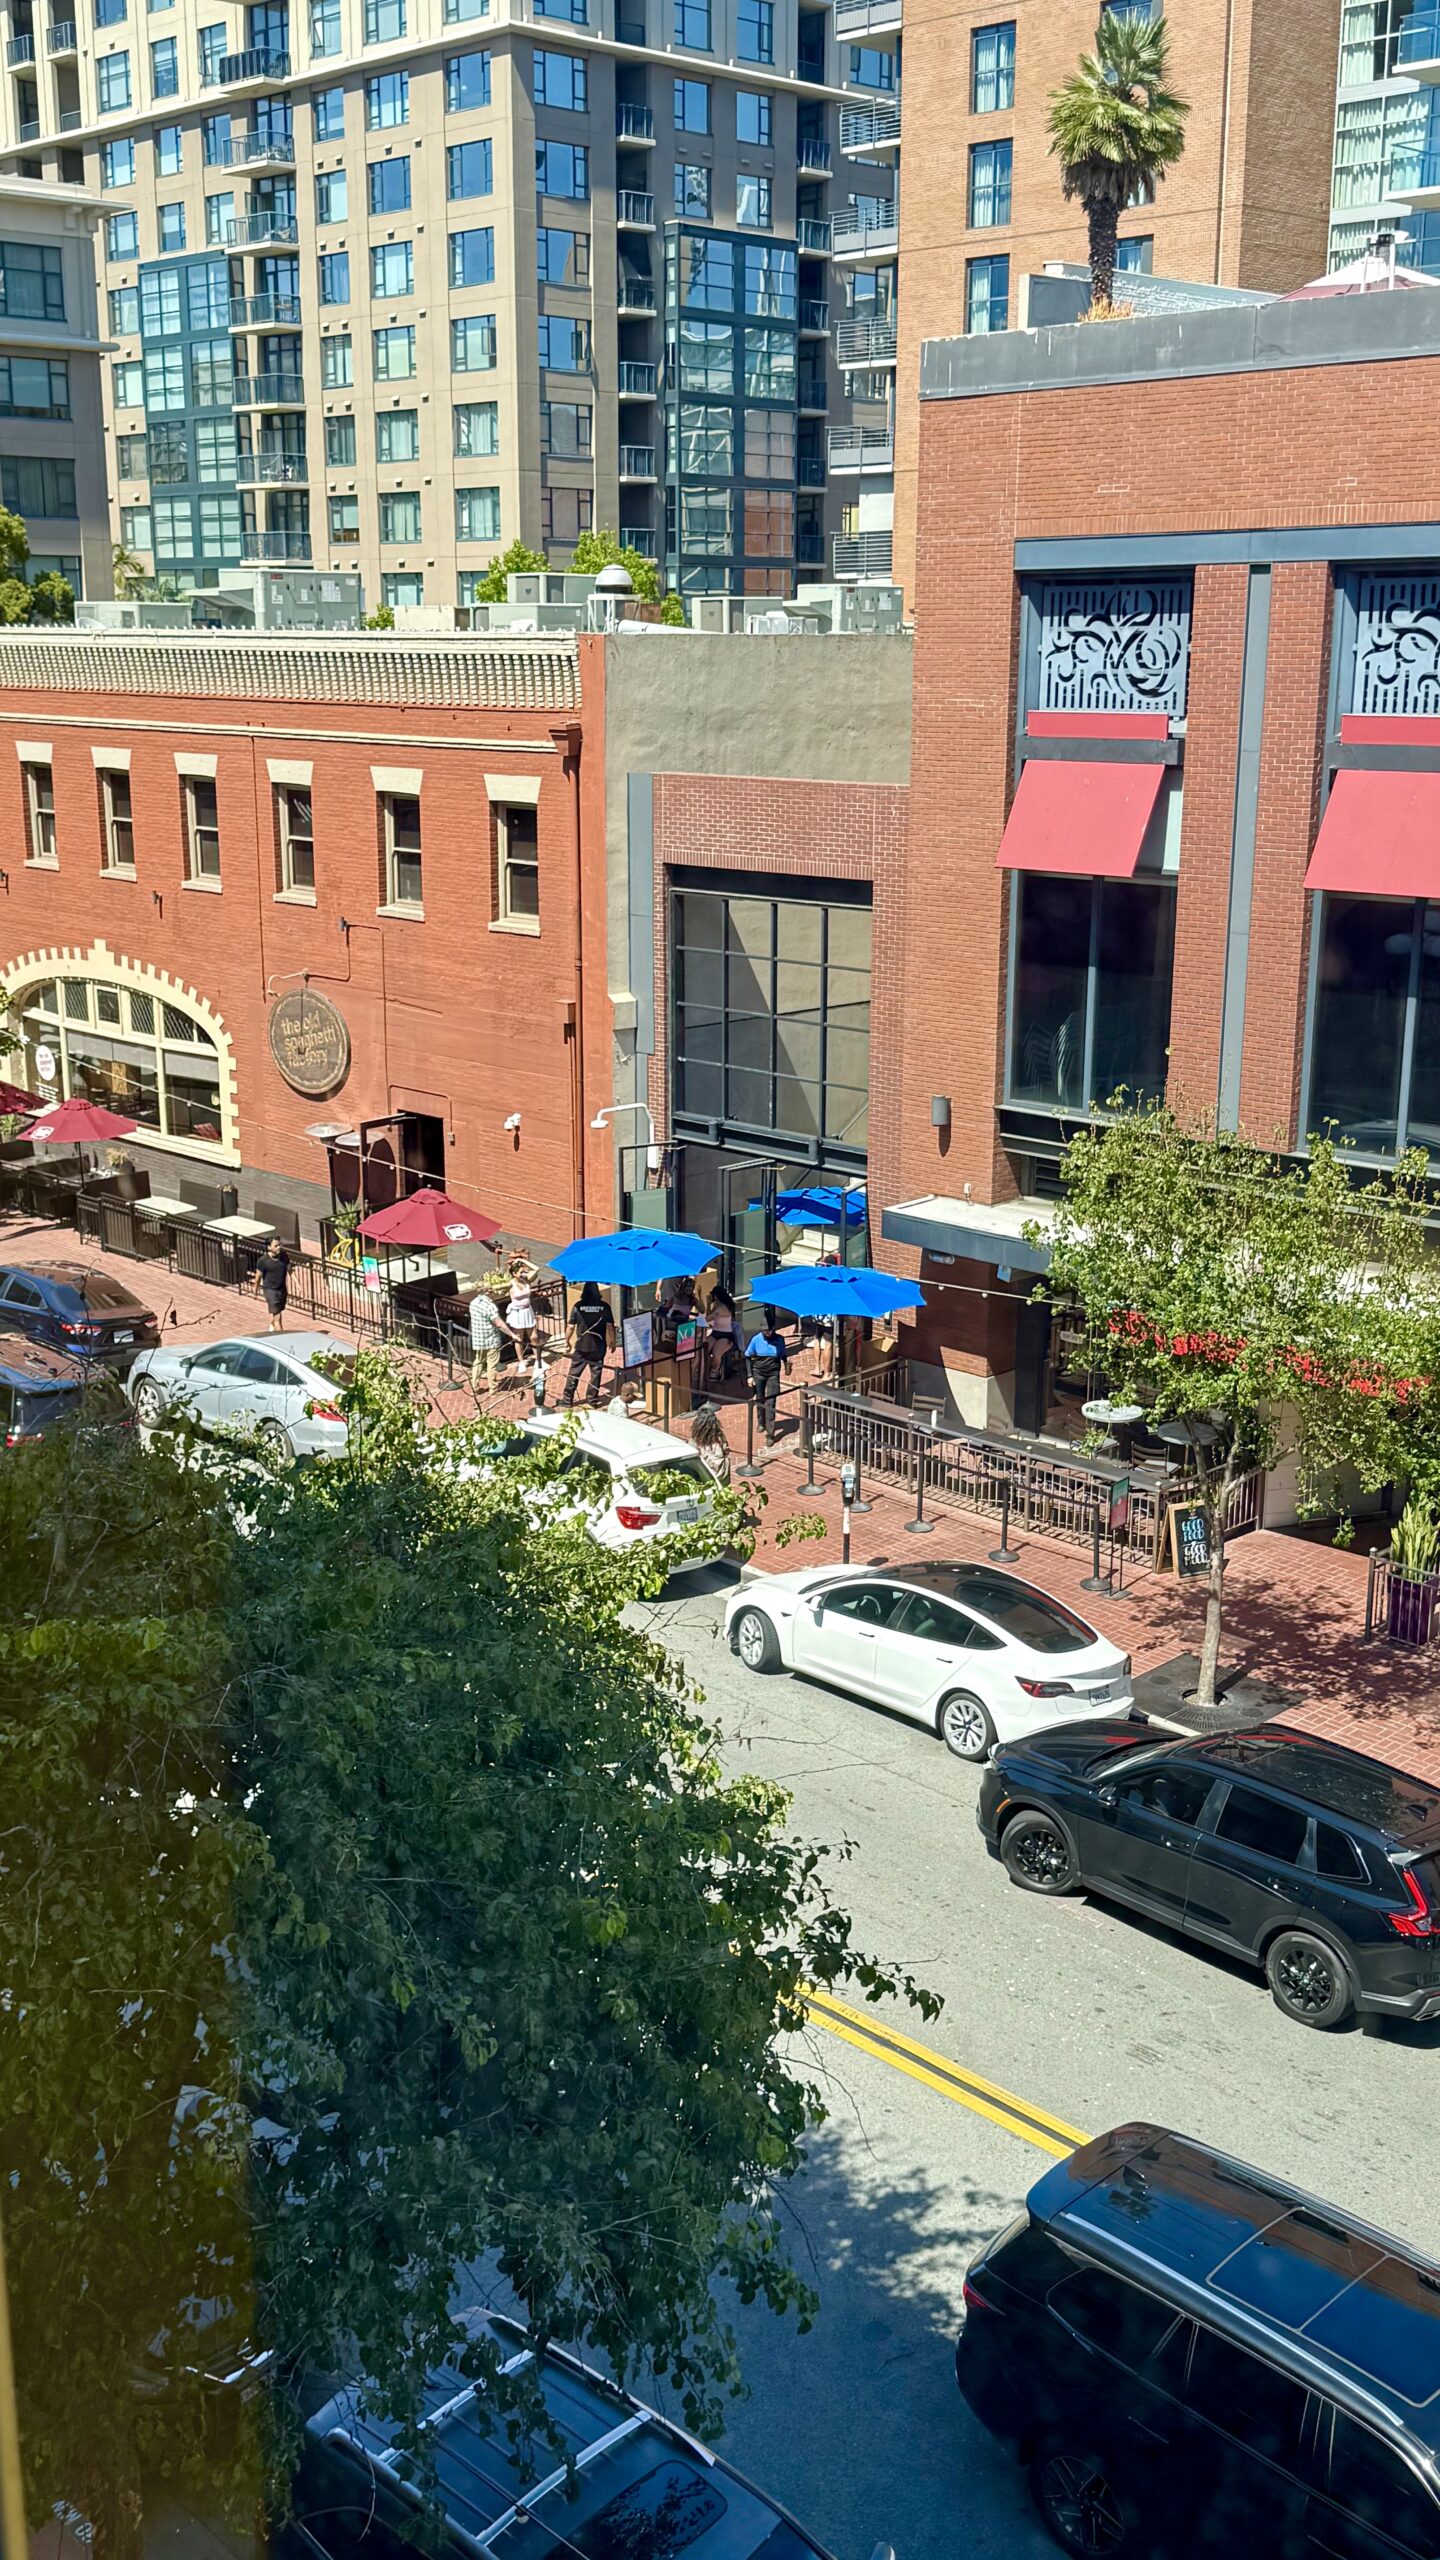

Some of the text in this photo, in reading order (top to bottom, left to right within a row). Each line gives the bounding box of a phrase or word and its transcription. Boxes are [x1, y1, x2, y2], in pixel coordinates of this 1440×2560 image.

[281, 1009, 320, 1036] the old
[284, 1025, 337, 1051] spaghetti
[1182, 1519, 1204, 1532] GOOD
[1183, 1529, 1205, 1542] FOOD
[1184, 1543, 1207, 1556] GOOD
